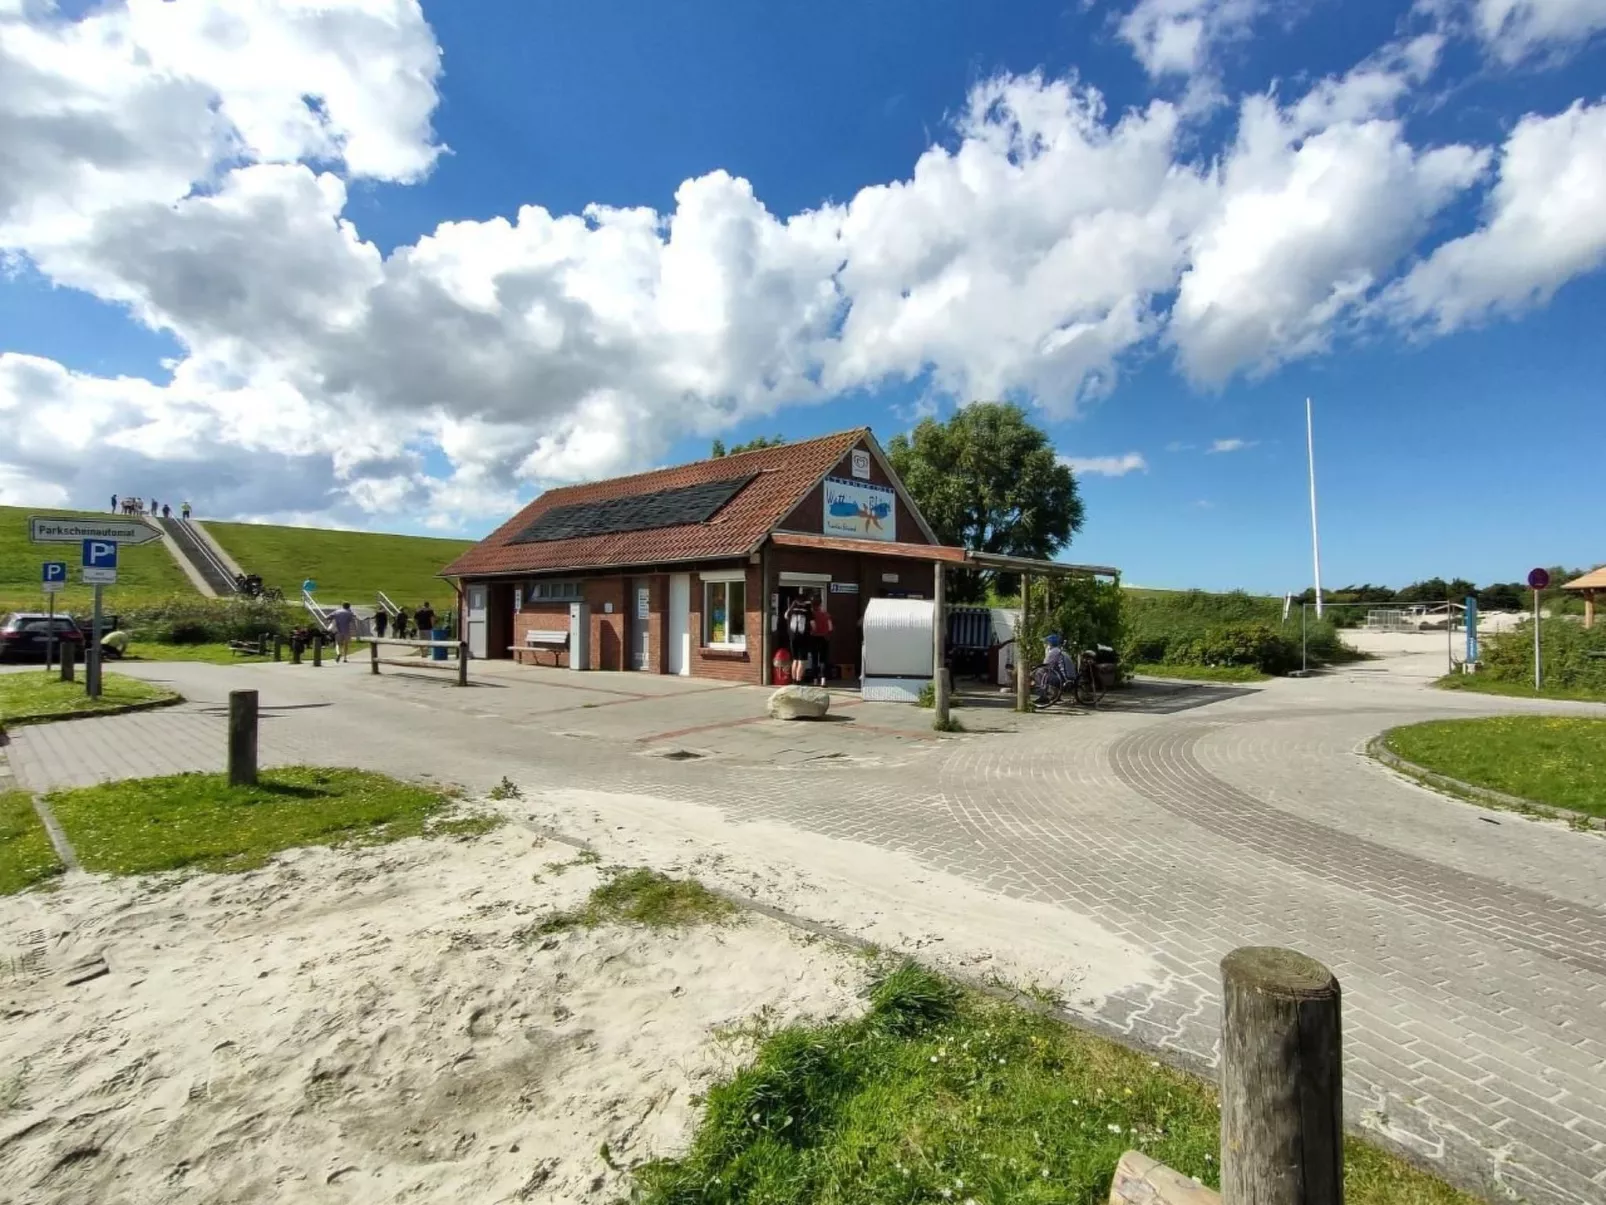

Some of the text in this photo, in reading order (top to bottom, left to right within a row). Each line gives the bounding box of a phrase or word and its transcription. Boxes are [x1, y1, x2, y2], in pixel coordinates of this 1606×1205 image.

[39, 525, 135, 537] Parkscheinautomat
[90, 542, 108, 564] P
[48, 564, 61, 580] P
